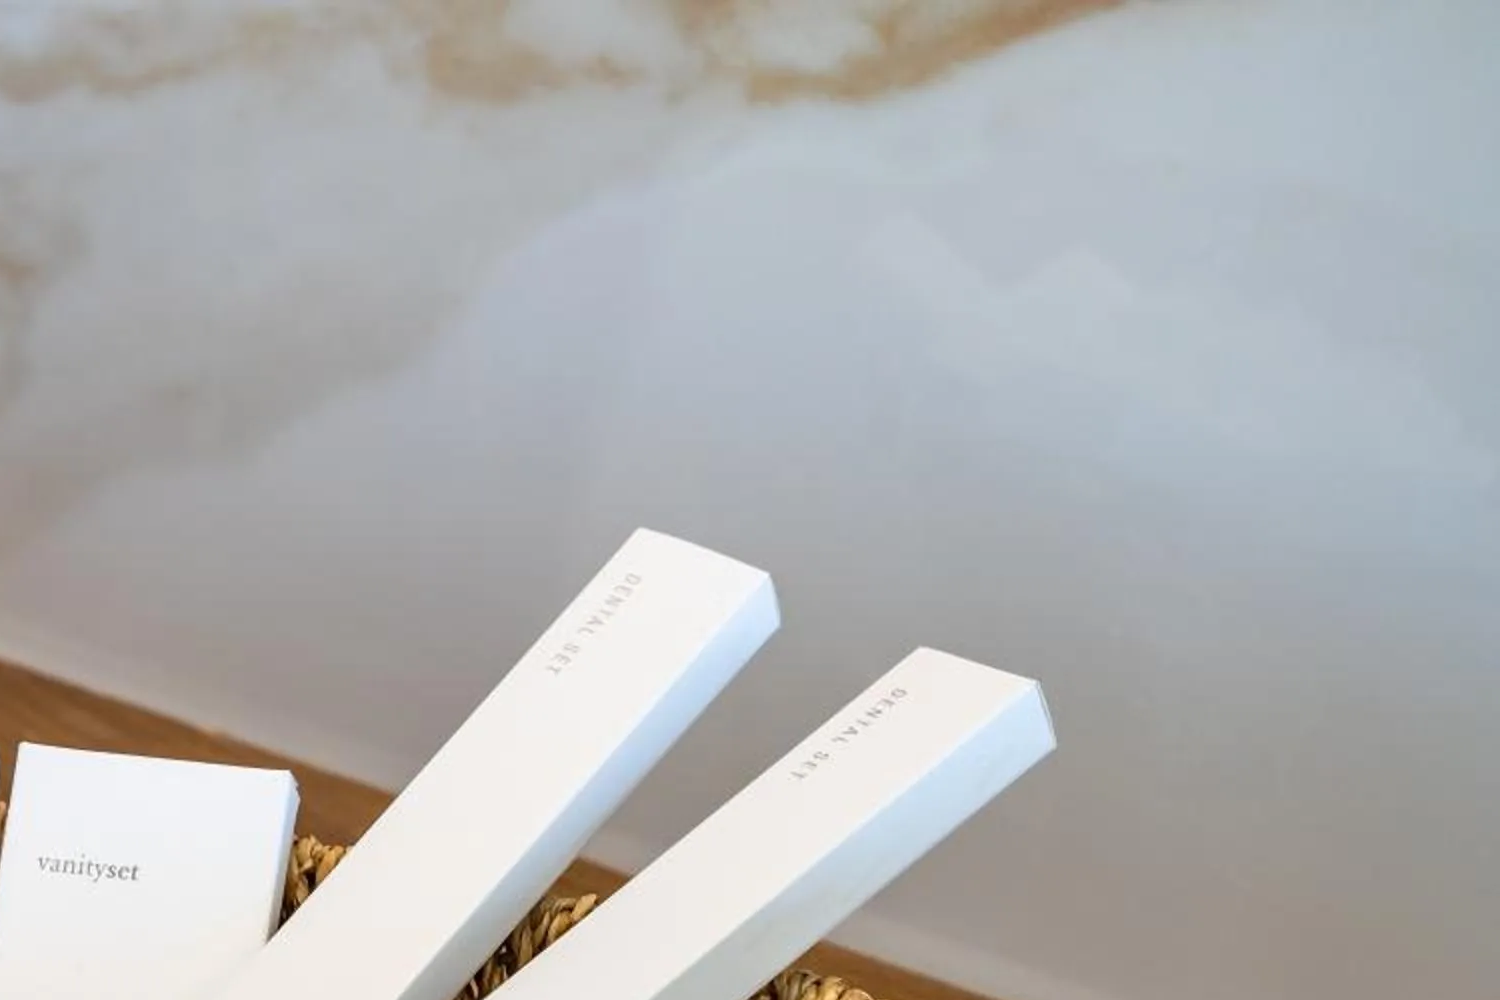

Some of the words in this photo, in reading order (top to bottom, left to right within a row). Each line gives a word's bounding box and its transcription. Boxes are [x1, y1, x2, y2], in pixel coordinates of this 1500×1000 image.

[580, 572, 642, 636] DENTAL
[546, 641, 581, 677] SET
[831, 686, 909, 746] DENTAL
[790, 749, 830, 782] SET
[37, 853, 141, 883] vanityset
